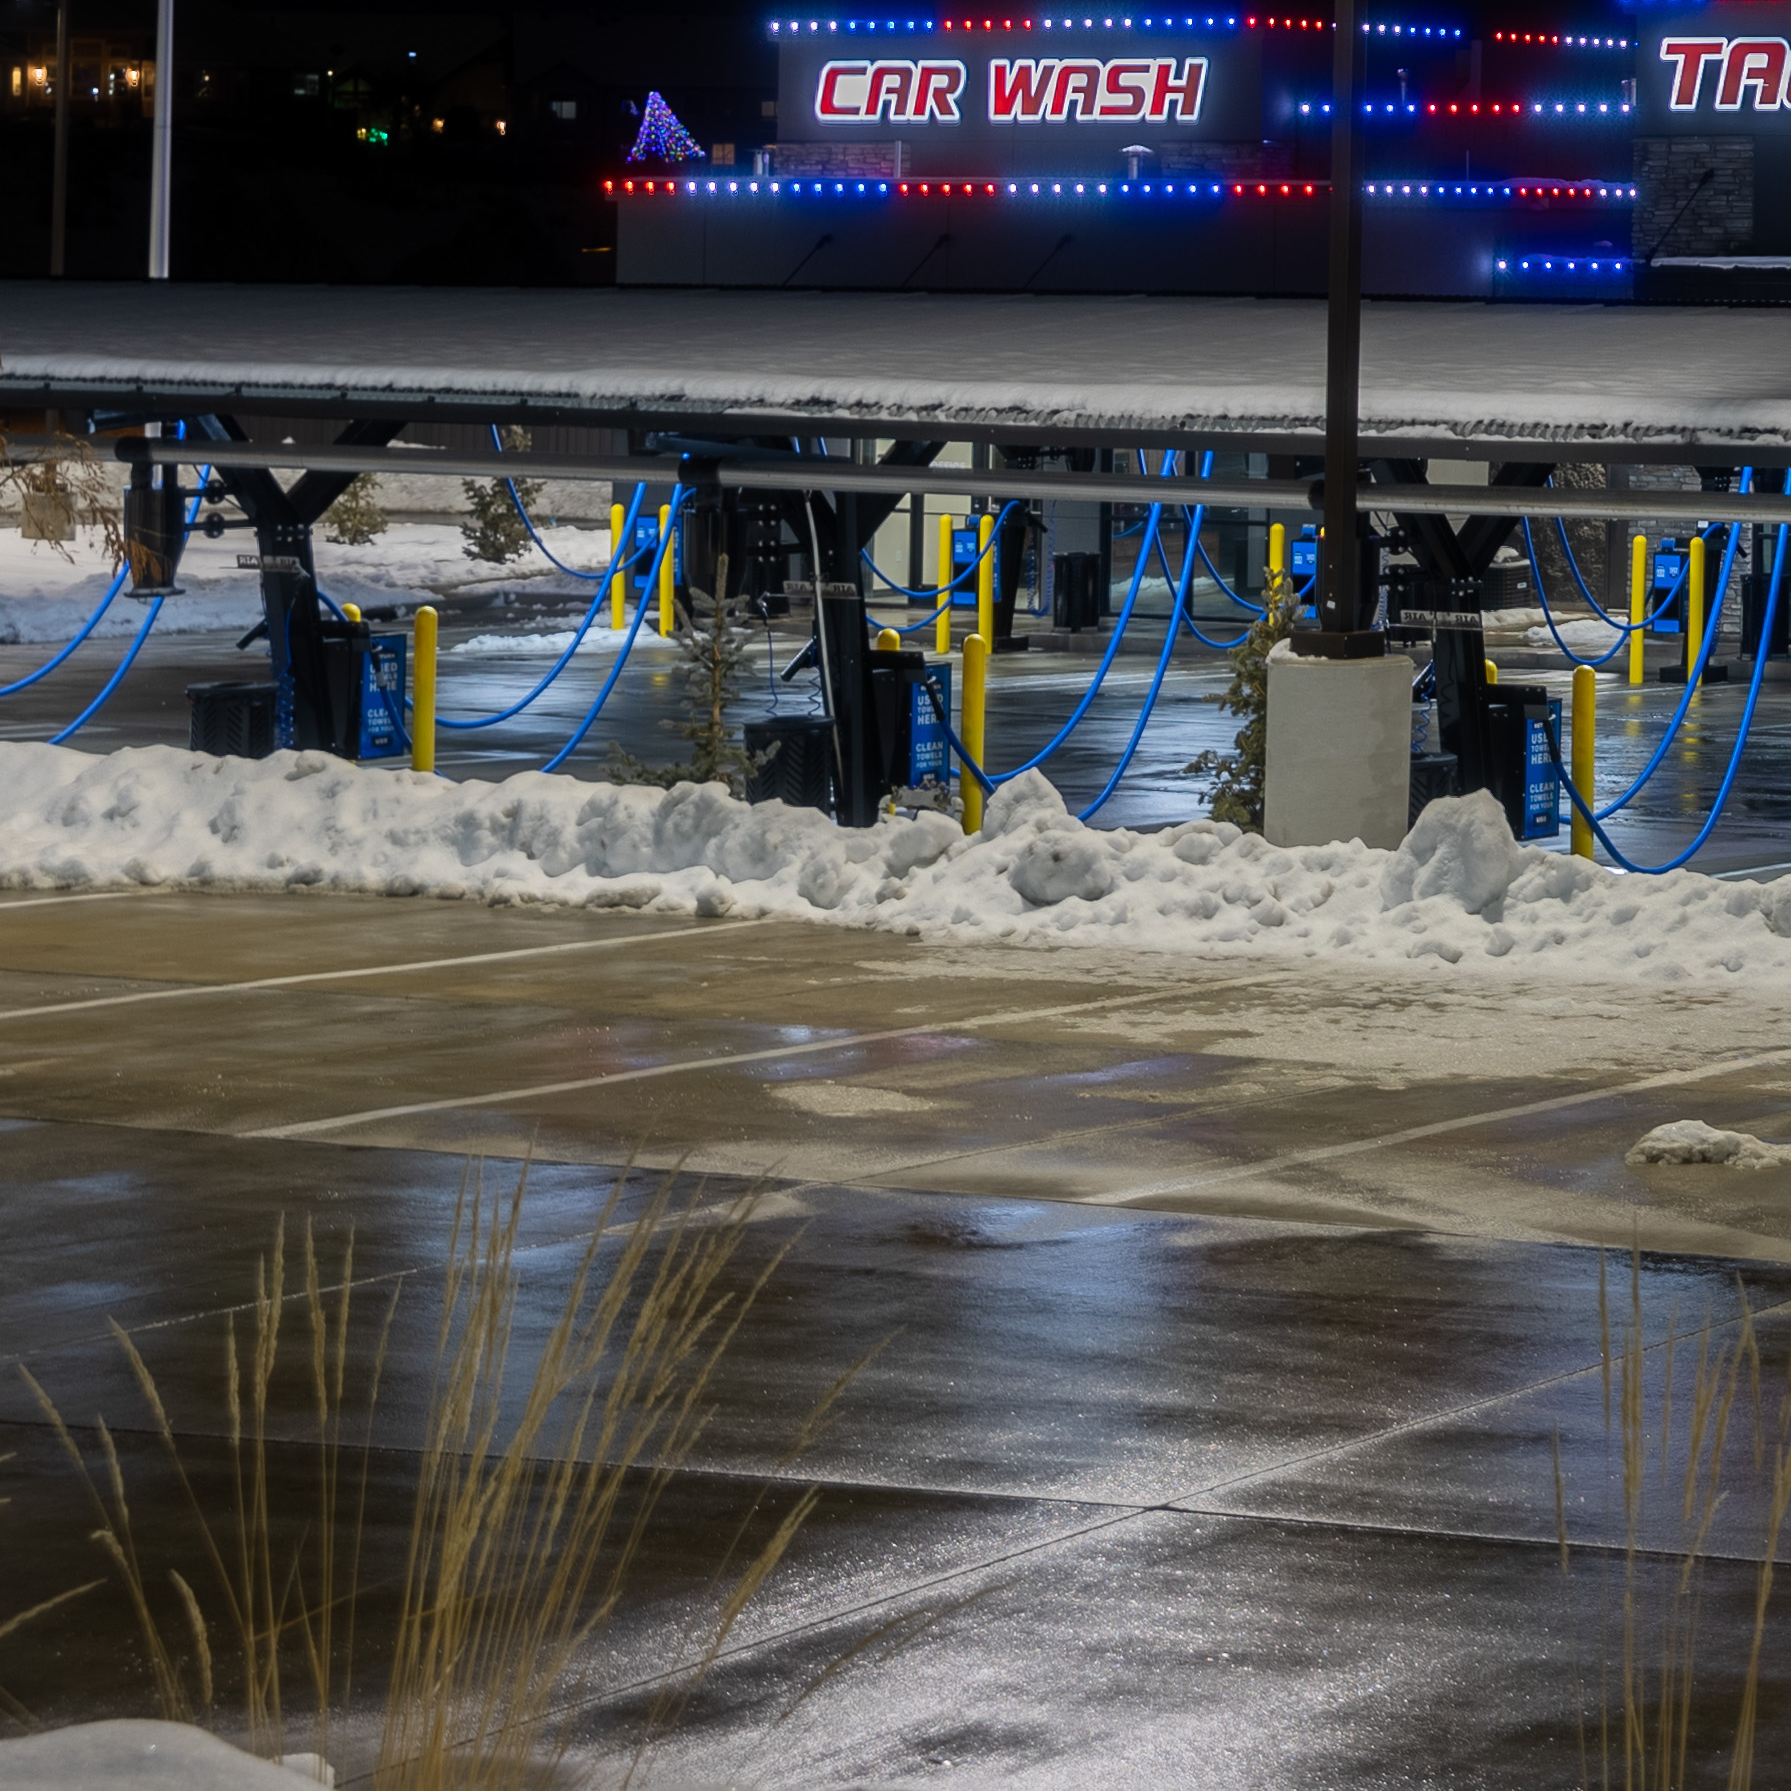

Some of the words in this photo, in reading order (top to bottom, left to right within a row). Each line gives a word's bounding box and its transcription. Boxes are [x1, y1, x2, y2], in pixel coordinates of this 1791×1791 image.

[815, 59, 966, 124] CAR
[988, 58, 1208, 124] WASH
[915, 741, 944, 753] CLEAN
[1529, 781, 1555, 794] CLEAN
[1530, 792, 1554, 803] TOWELS
